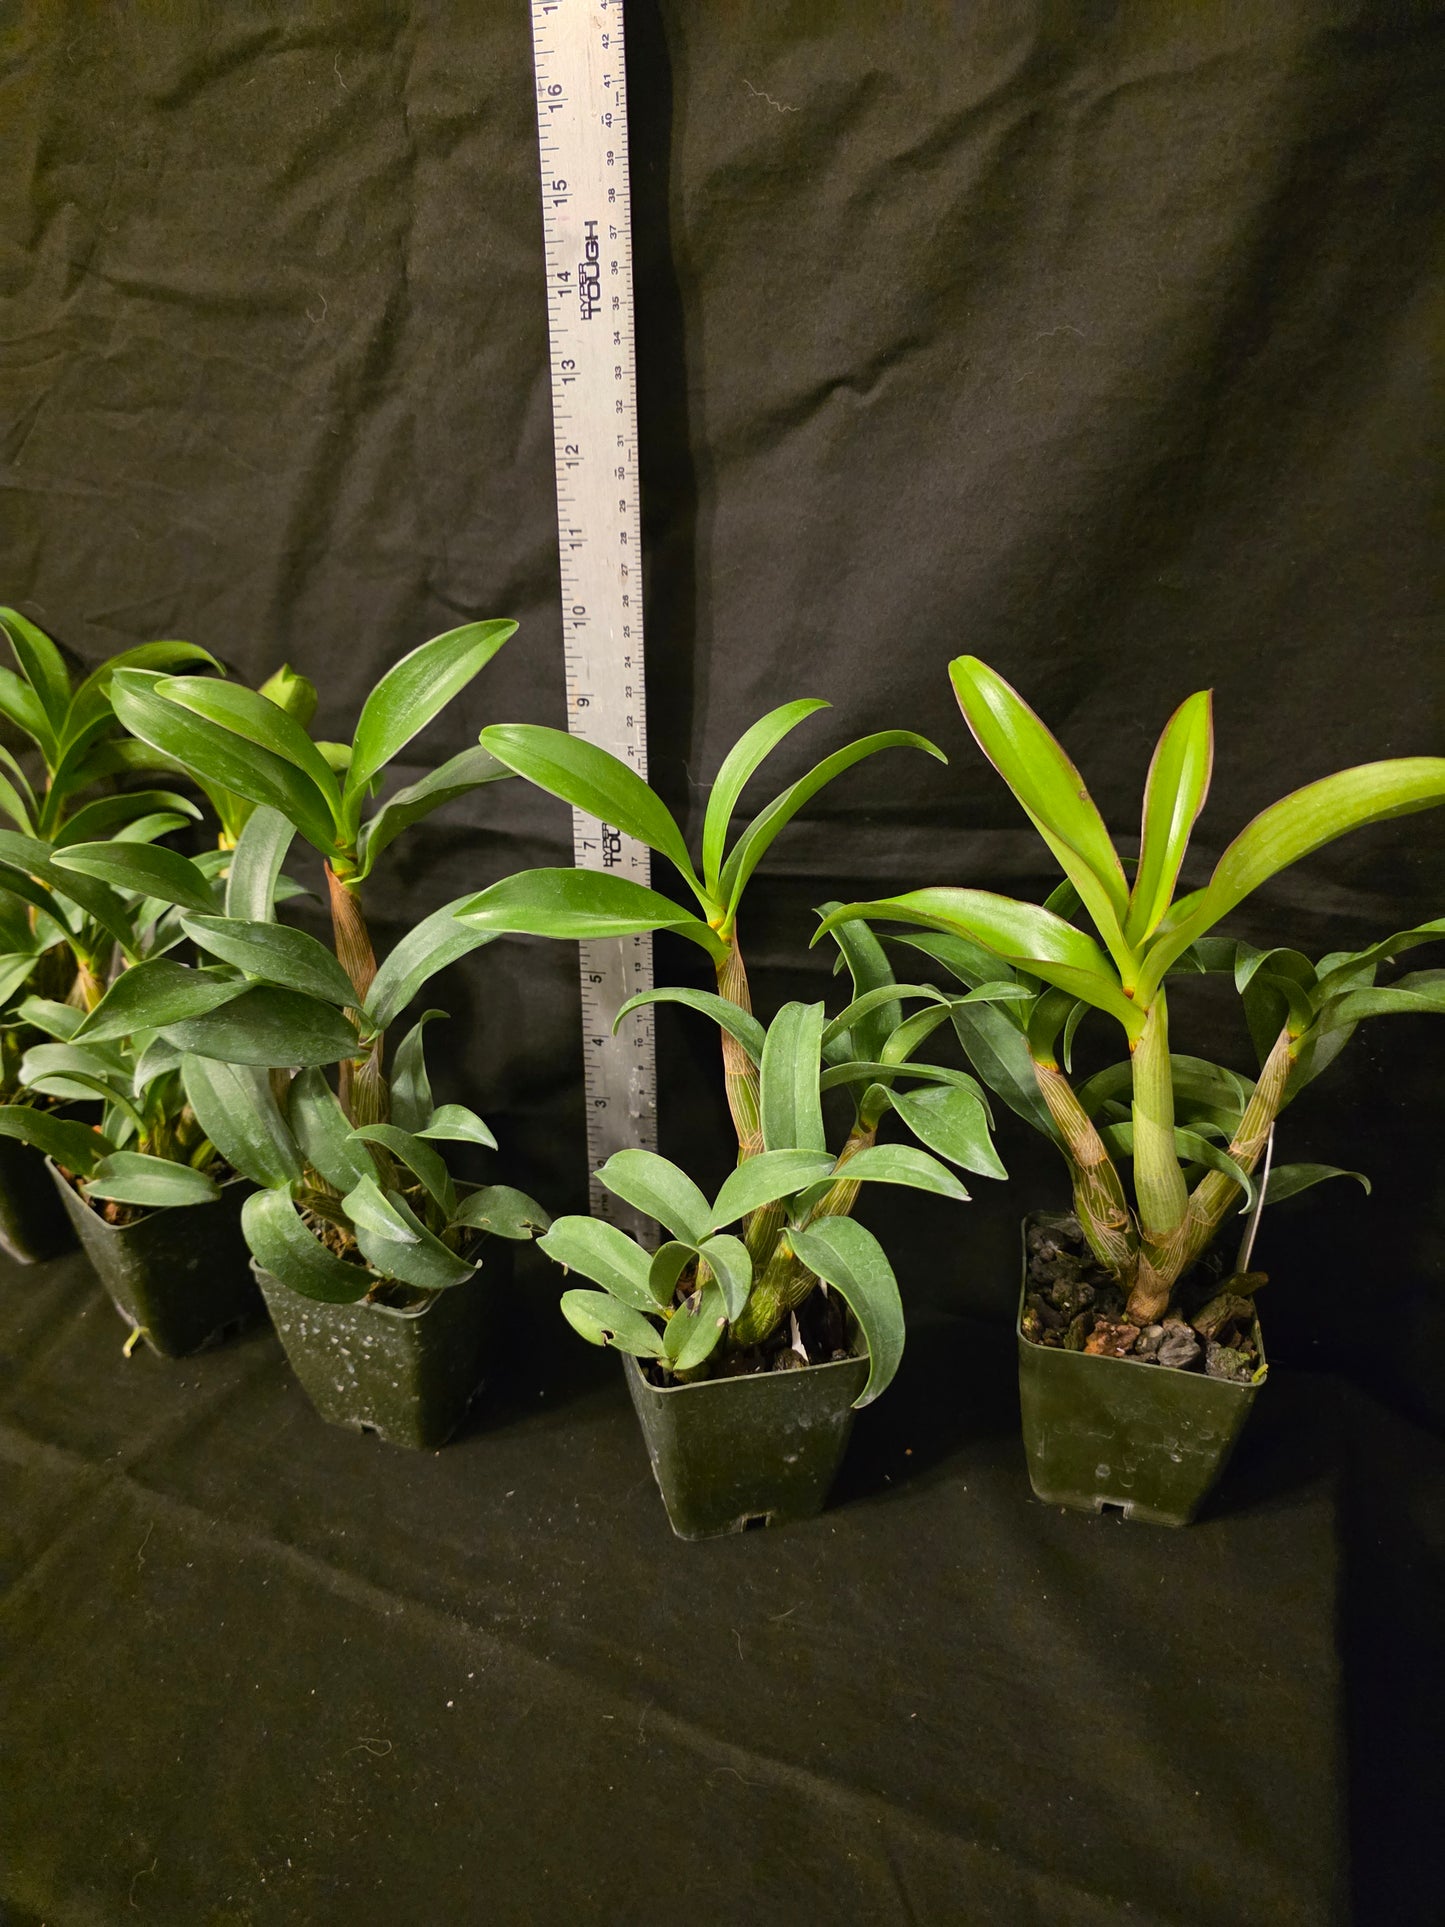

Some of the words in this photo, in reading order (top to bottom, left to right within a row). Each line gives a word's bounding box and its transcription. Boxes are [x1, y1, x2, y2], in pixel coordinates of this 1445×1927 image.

[602, 33, 609, 49] 42
[604, 74, 611, 88] 41
[547, 84, 563, 113] 16
[605, 113, 612, 128] 40
[607, 150, 614, 166] 39
[552, 179, 567, 207] 15
[608, 188, 615, 203] 38
[609, 225, 617, 240] 37
[584, 221, 601, 320] TOUGH
[611, 260, 618, 275] 36
[557, 271, 571, 297] 14
[578, 263, 591, 320] HYPER
[612, 296, 620, 311] 35
[613, 331, 621, 345] 34
[561, 359, 575, 385] 13
[614, 366, 622, 380] 33
[616, 400, 623, 413] 32
[617, 435, 624, 447] 31
[565, 444, 579, 469] 12
[618, 467, 625, 480] 30
[619, 500, 626, 513] 29
[568, 529, 582, 550] 11
[620, 532, 627, 545] 28
[621, 563, 628, 576] 27
[622, 595, 629, 607] 26
[572, 605, 586, 629] 10
[623, 625, 630, 638] 25
[624, 656, 631, 668] 24
[625, 686, 632, 698] 23
[576, 697, 589, 707] 9
[626, 715, 633, 728] 22
[627, 745, 634, 756] 21
[584, 841, 596, 850] 7
[631, 856, 638, 867] 17
[633, 936, 640, 947] 14
[634, 962, 642, 972] 13
[589, 974, 602, 984] 5
[636, 1014, 643, 1023] 11
[591, 1038, 604, 1047] 4
[637, 1037, 644, 1047] 10
[595, 1099, 607, 1109] 3
